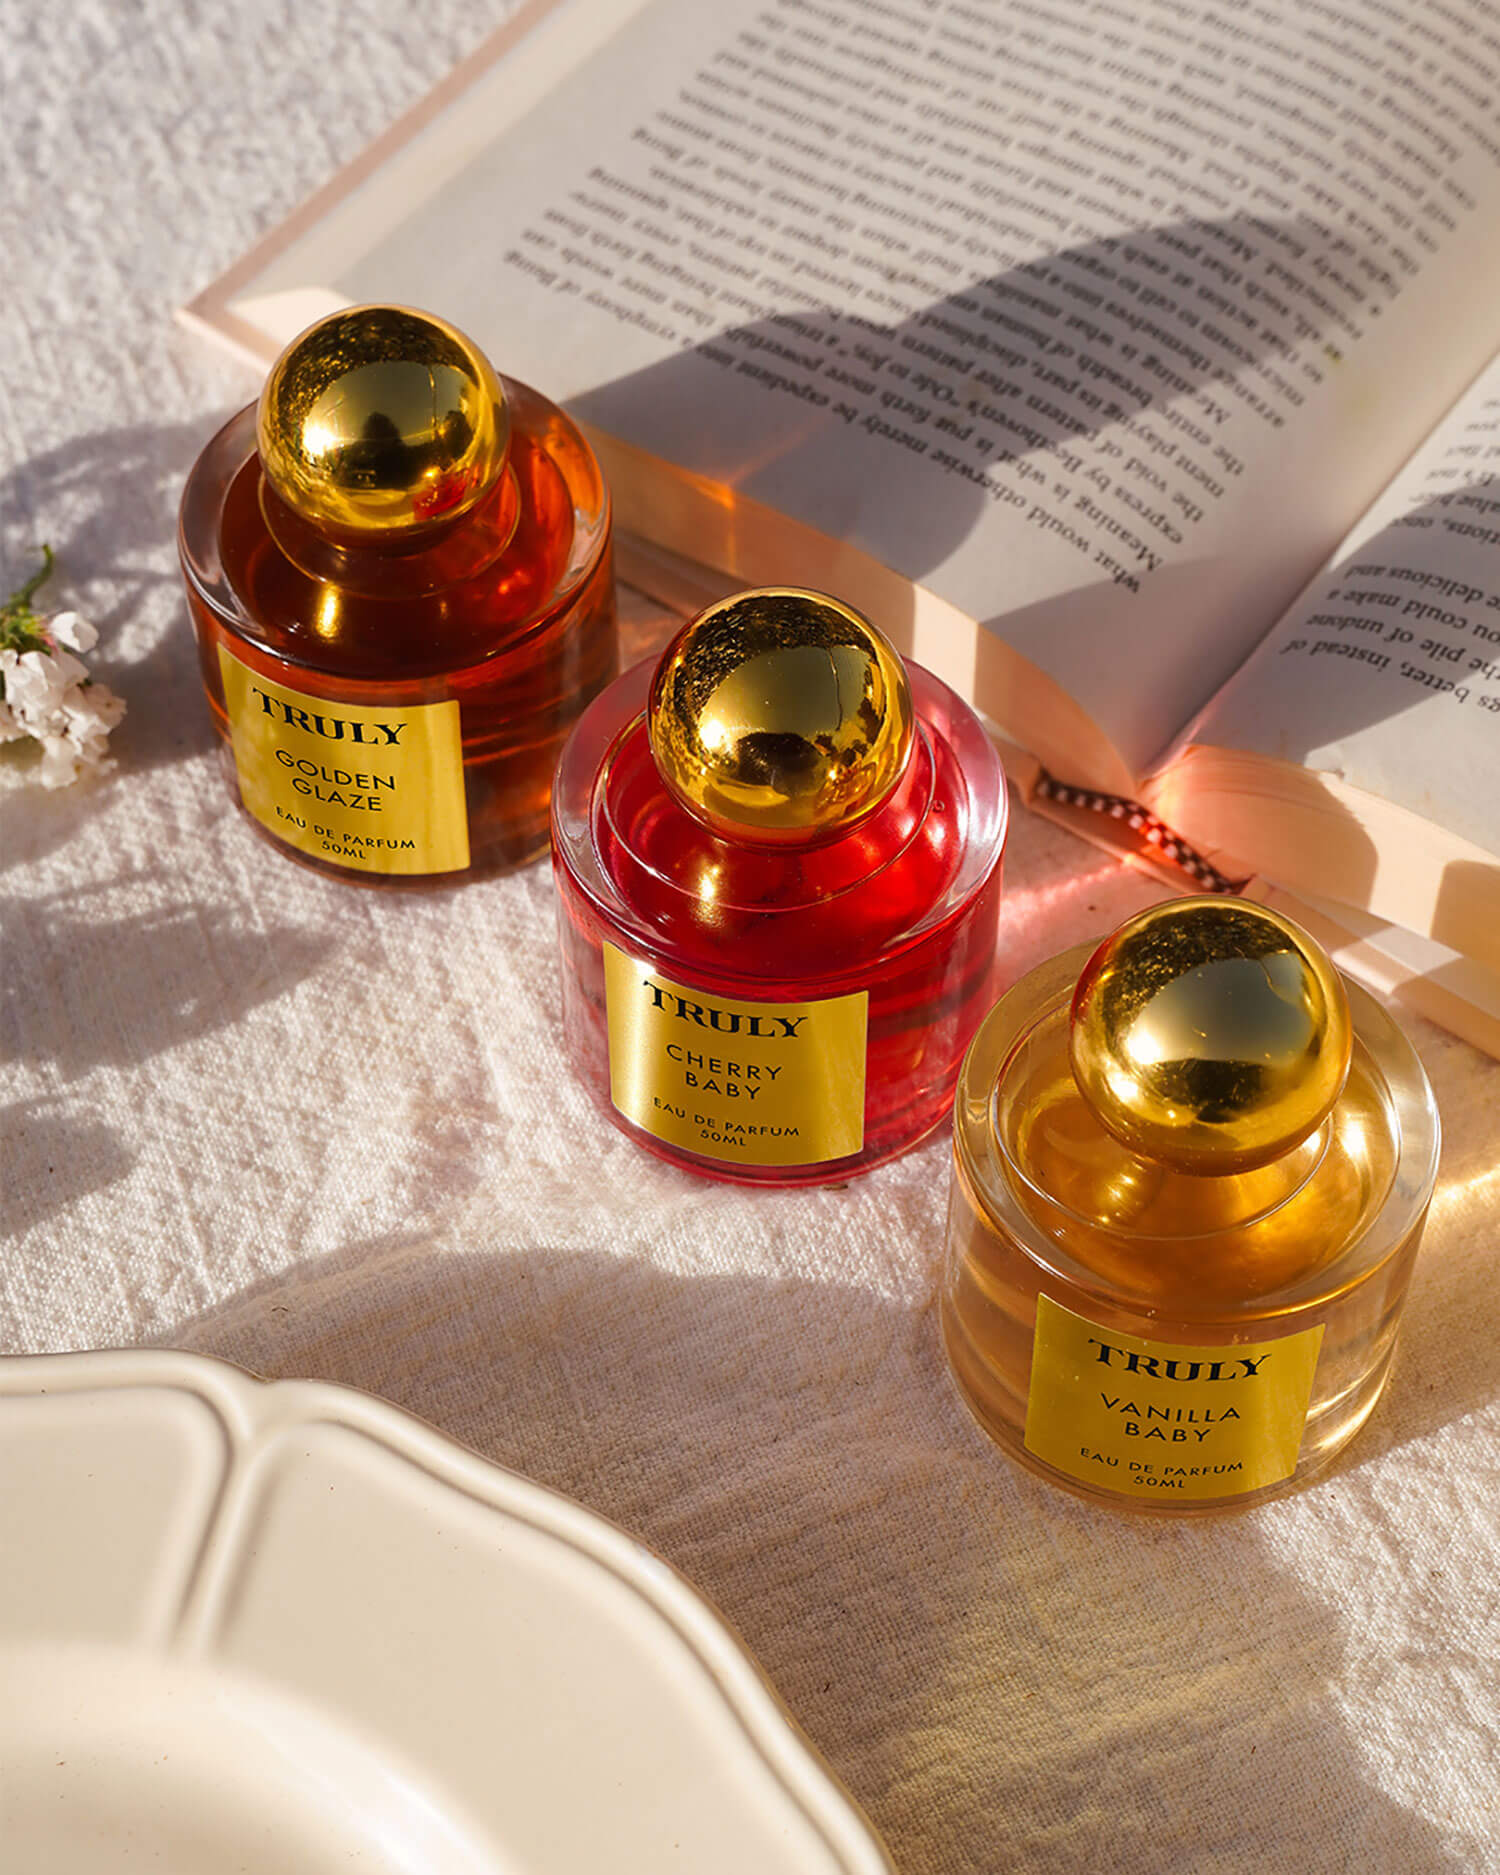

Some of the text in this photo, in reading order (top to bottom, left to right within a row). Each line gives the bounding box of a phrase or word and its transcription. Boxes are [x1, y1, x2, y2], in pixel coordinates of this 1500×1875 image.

[734, 360, 829, 408] expedient
[822, 367, 875, 397] more
[831, 402, 858, 425] be
[875, 391, 931, 427] forth
[1077, 388, 1103, 413] its
[864, 412, 927, 454] merely
[932, 417, 974, 443] put
[973, 437, 994, 458] is
[929, 449, 1027, 509] otherwise
[996, 450, 1046, 486] what
[1051, 483, 1070, 505] is
[1027, 505, 1090, 553] would
[1072, 492, 1161, 577] Meaning
[1093, 550, 1139, 593] what
[1347, 564, 1485, 603] delicious and
[1327, 588, 1341, 602] a
[1343, 589, 1402, 614] make
[1307, 612, 1385, 635] undone
[1402, 599, 1468, 631] could
[1279, 637, 1307, 656] of
[1384, 625, 1415, 647] of
[1420, 638, 1466, 665] pile
[1310, 639, 1390, 670] instead
[1400, 660, 1469, 704] better,
[252, 687, 408, 745] TRULY
[275, 749, 396, 791] GOLDEN
[292, 777, 382, 812] GLAZE
[276, 806, 416, 850] EAU DE PARFUM
[321, 840, 366, 860] 50ML
[643, 980, 808, 1038] TRULY
[666, 1043, 783, 1081] CHERRY
[685, 1071, 761, 1100] BABY
[653, 1096, 799, 1137] EAU DE PARFUM
[700, 1129, 747, 1147] 50ML
[1087, 1338, 1272, 1382] TRULY
[1101, 1392, 1241, 1423] VANILLA
[1124, 1421, 1211, 1443] BABY
[1080, 1447, 1243, 1476] EAU DE PARFUM
[1133, 1475, 1185, 1489] 50ML
